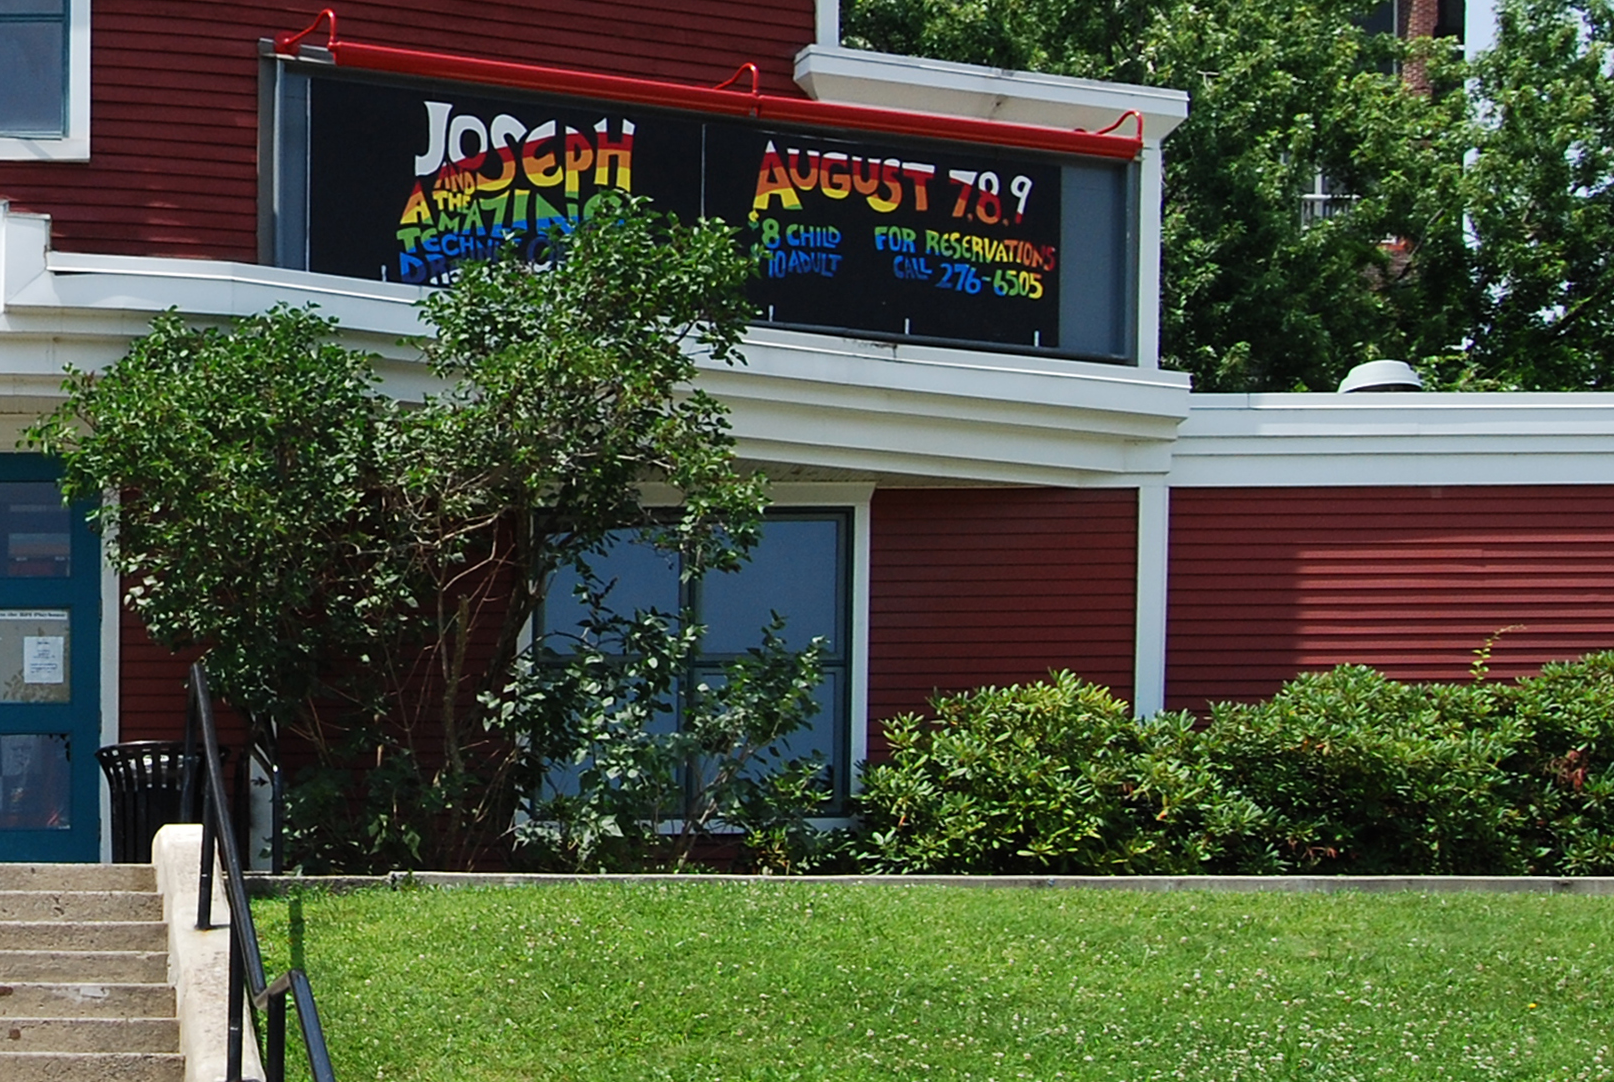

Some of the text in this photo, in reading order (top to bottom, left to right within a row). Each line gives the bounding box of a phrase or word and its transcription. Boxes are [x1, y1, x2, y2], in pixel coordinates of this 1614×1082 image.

[415, 101, 636, 200] JOSEPH
[753, 140, 936, 213] AUGUST
[432, 190, 471, 214] THE
[786, 224, 842, 248] CHILD
[875, 226, 1055, 271] FOR RESERVATIONS
[788, 250, 843, 277] ADULT
[893, 255, 1044, 299] CALL 276-6505
